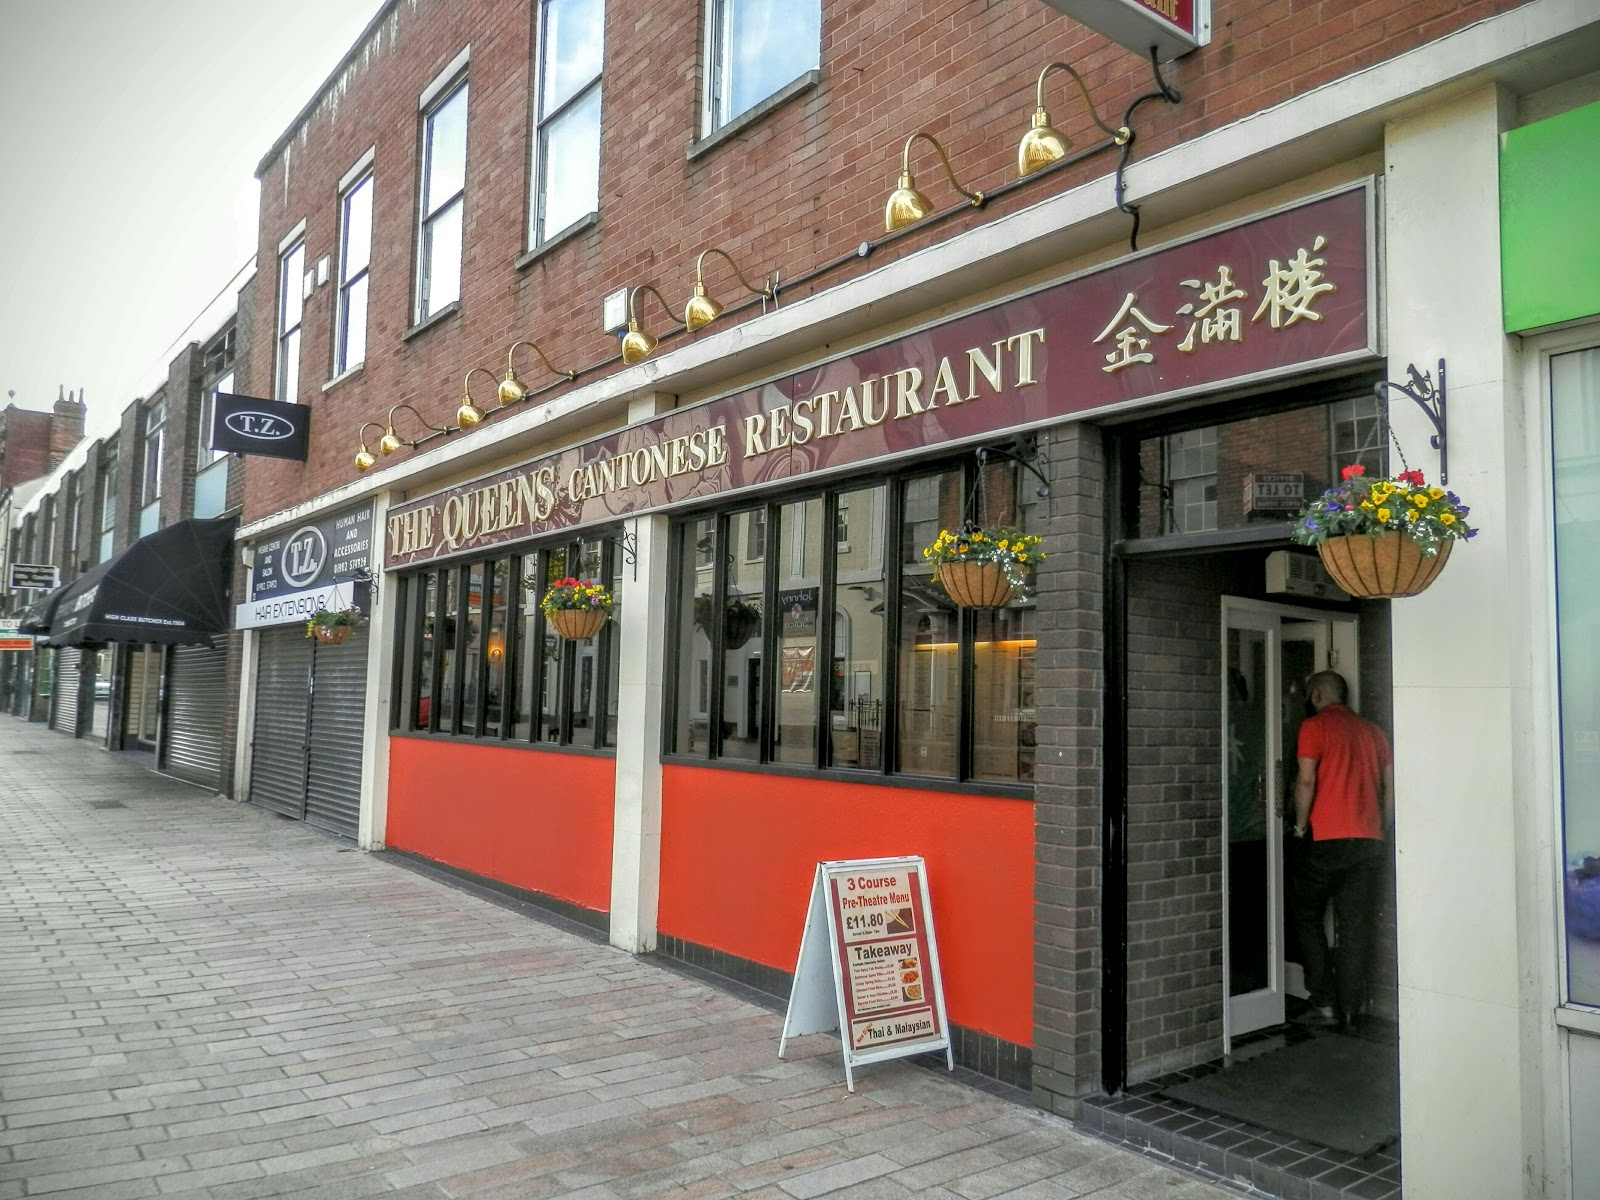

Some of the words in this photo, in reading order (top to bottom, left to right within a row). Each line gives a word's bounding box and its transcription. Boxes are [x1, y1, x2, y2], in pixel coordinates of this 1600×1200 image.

[240, 415, 281, 436] T.Z.
[387, 505, 435, 557] THE
[442, 466, 556, 550] QUEENS
[568, 425, 728, 503] CANTONESE
[743, 328, 1046, 459] RESTAURANT
[335, 514, 356, 530] HUMAN
[357, 509, 370, 523] HAIR
[345, 528, 358, 541] AND
[333, 539, 369, 559] ACCESSORIES
[255, 604, 272, 621] HAIR
[273, 595, 325, 618] EXTENSIONS
[846, 878, 856, 891] 3
[857, 876, 897, 890] Course
[842, 894, 888, 909] Pre-Theatre
[888, 892, 910, 904] Menu
[846, 912, 884, 930] £11.80
[854, 943, 912, 960] Takeaway
[868, 1026, 885, 1039] Thai
[886, 1025, 893, 1036] &
[895, 1020, 931, 1035] Malaysian
